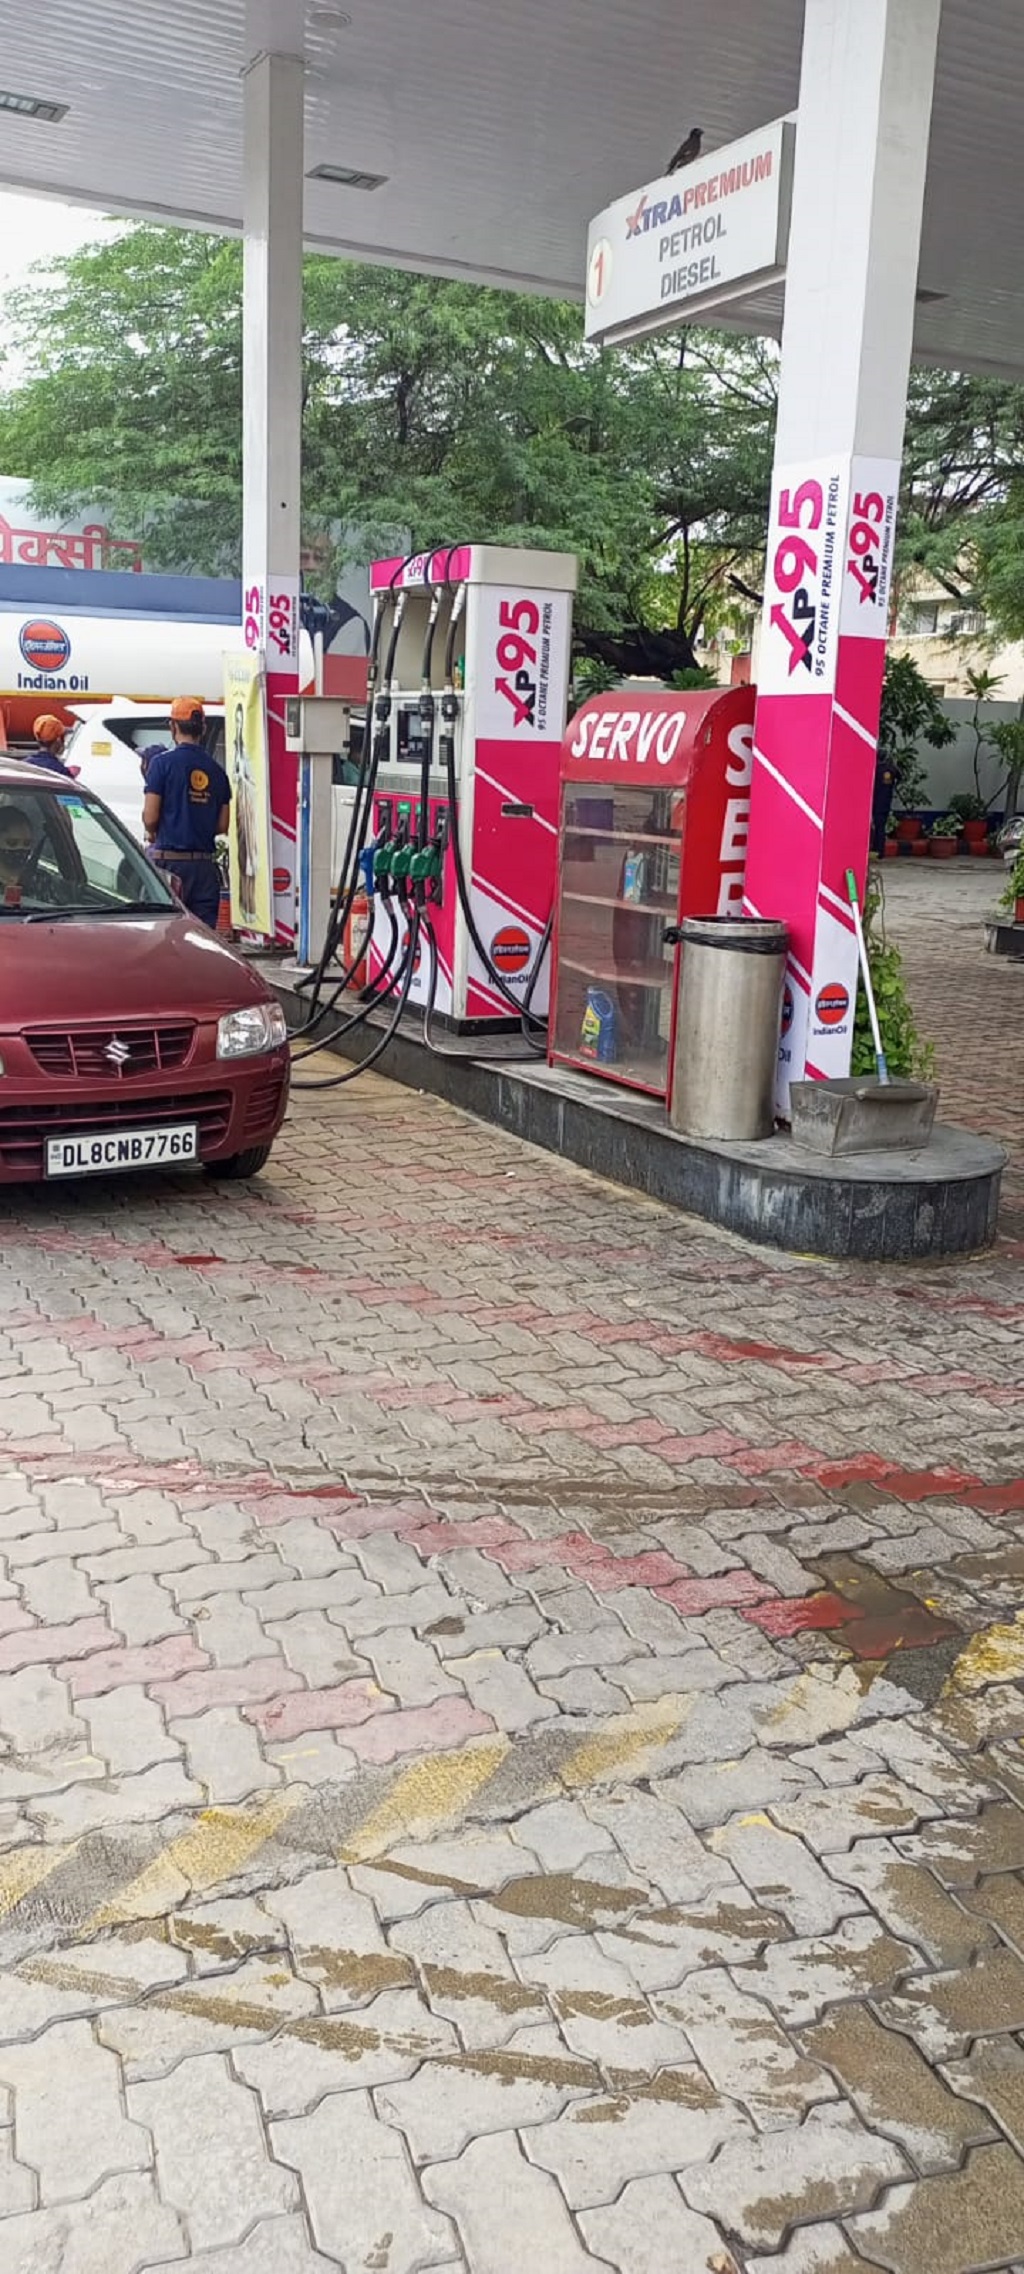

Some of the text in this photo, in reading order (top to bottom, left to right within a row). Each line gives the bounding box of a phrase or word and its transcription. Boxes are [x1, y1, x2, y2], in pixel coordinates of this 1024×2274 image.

[659, 213, 727, 263] PETROL
[594, 251, 603, 297] 1
[660, 255, 722, 300] DIESEL
[886, 495, 895, 525] PETROL
[847, 492, 884, 604] XP95
[882, 526, 892, 564] PREMIUM
[769, 479, 824, 678] XP95
[815, 475, 841, 677] 95 OCTANE PREMIUM PETROL
[879, 569, 888, 596] OCTANE
[245, 586, 260, 652] 95
[17, 673, 89, 691] Indian Oil
[495, 600, 540, 728] XP95
[538, 603, 553, 731] 95 OCTANE PREMIUM PETROL
[571, 711, 687, 765] SERVO
[813, 1025, 848, 1036] IndianOil
[63, 1132, 194, 1168] DL8CNB7766
